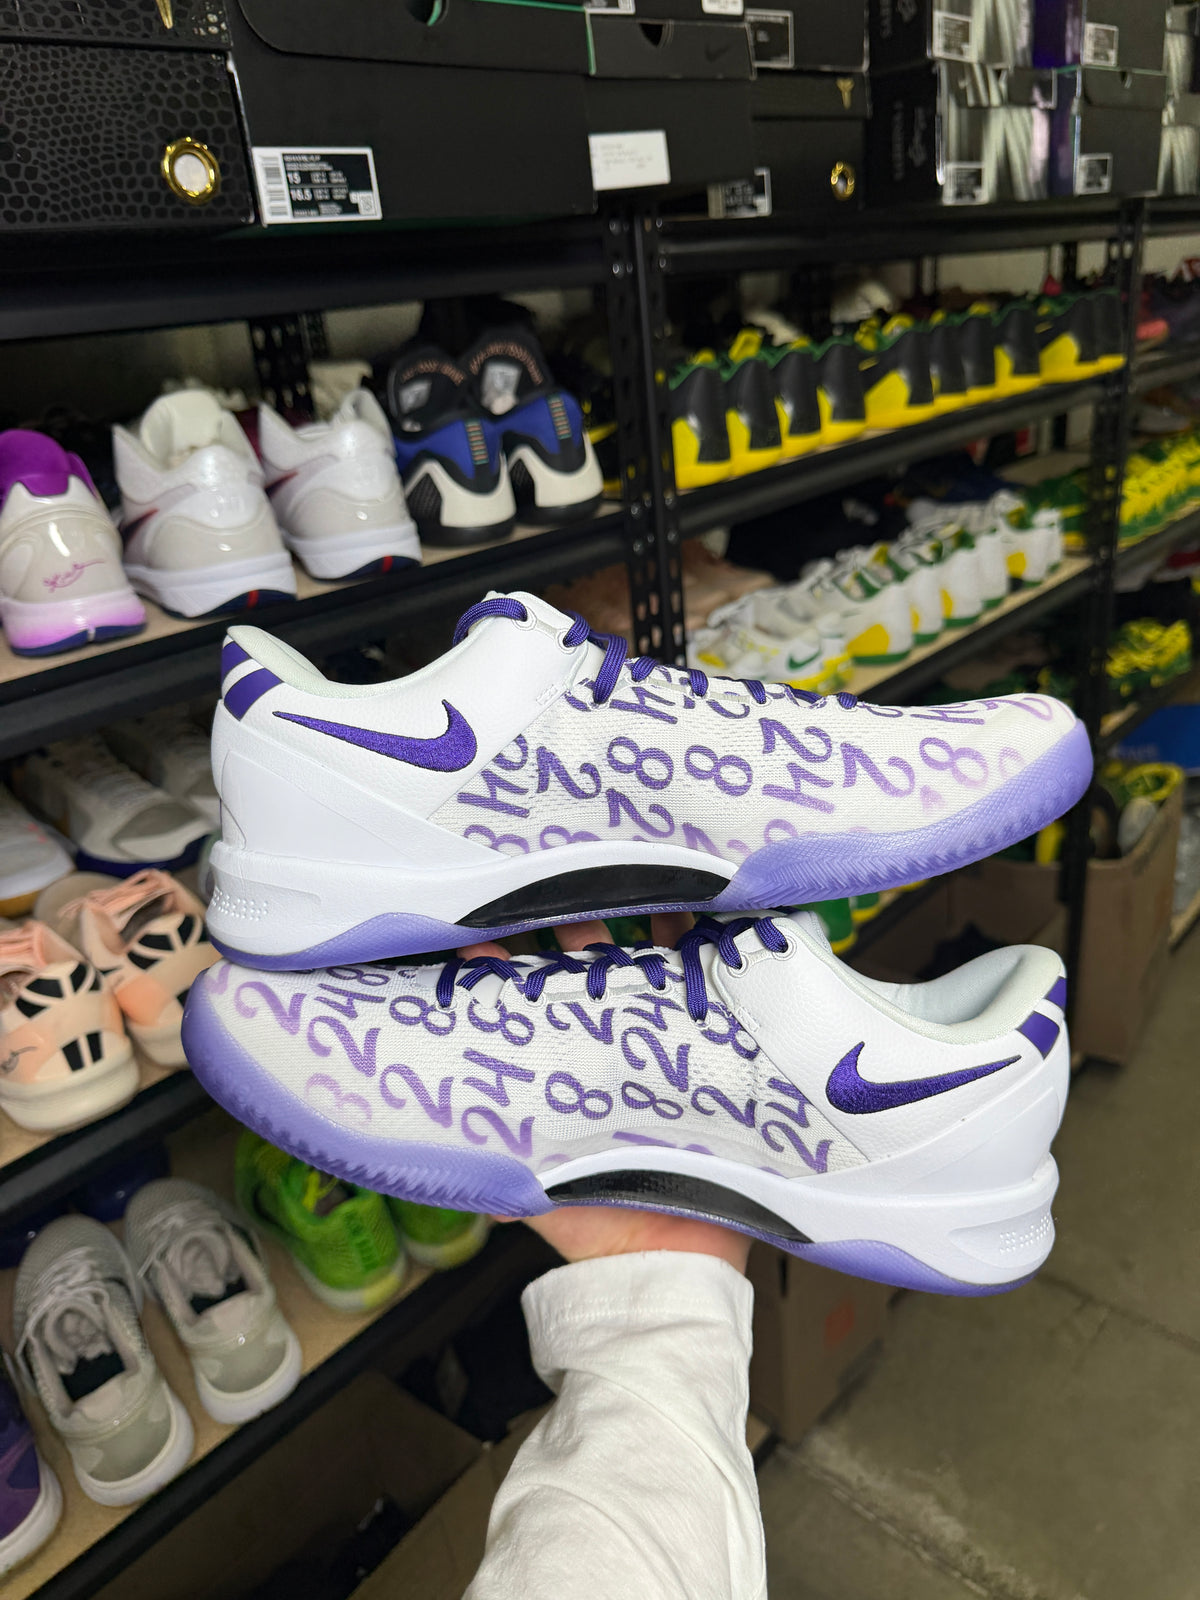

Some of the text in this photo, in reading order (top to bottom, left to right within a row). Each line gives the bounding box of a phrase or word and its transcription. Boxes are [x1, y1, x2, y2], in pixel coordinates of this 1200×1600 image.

[535, 746, 602, 800] 2
[685, 745, 753, 797] 8
[839, 742, 916, 798] 2
[919, 736, 989, 788] 8
[234, 981, 307, 1036] 2
[379, 1063, 454, 1129] 2
[545, 1071, 613, 1121] 8
[690, 1085, 756, 1128] 2
